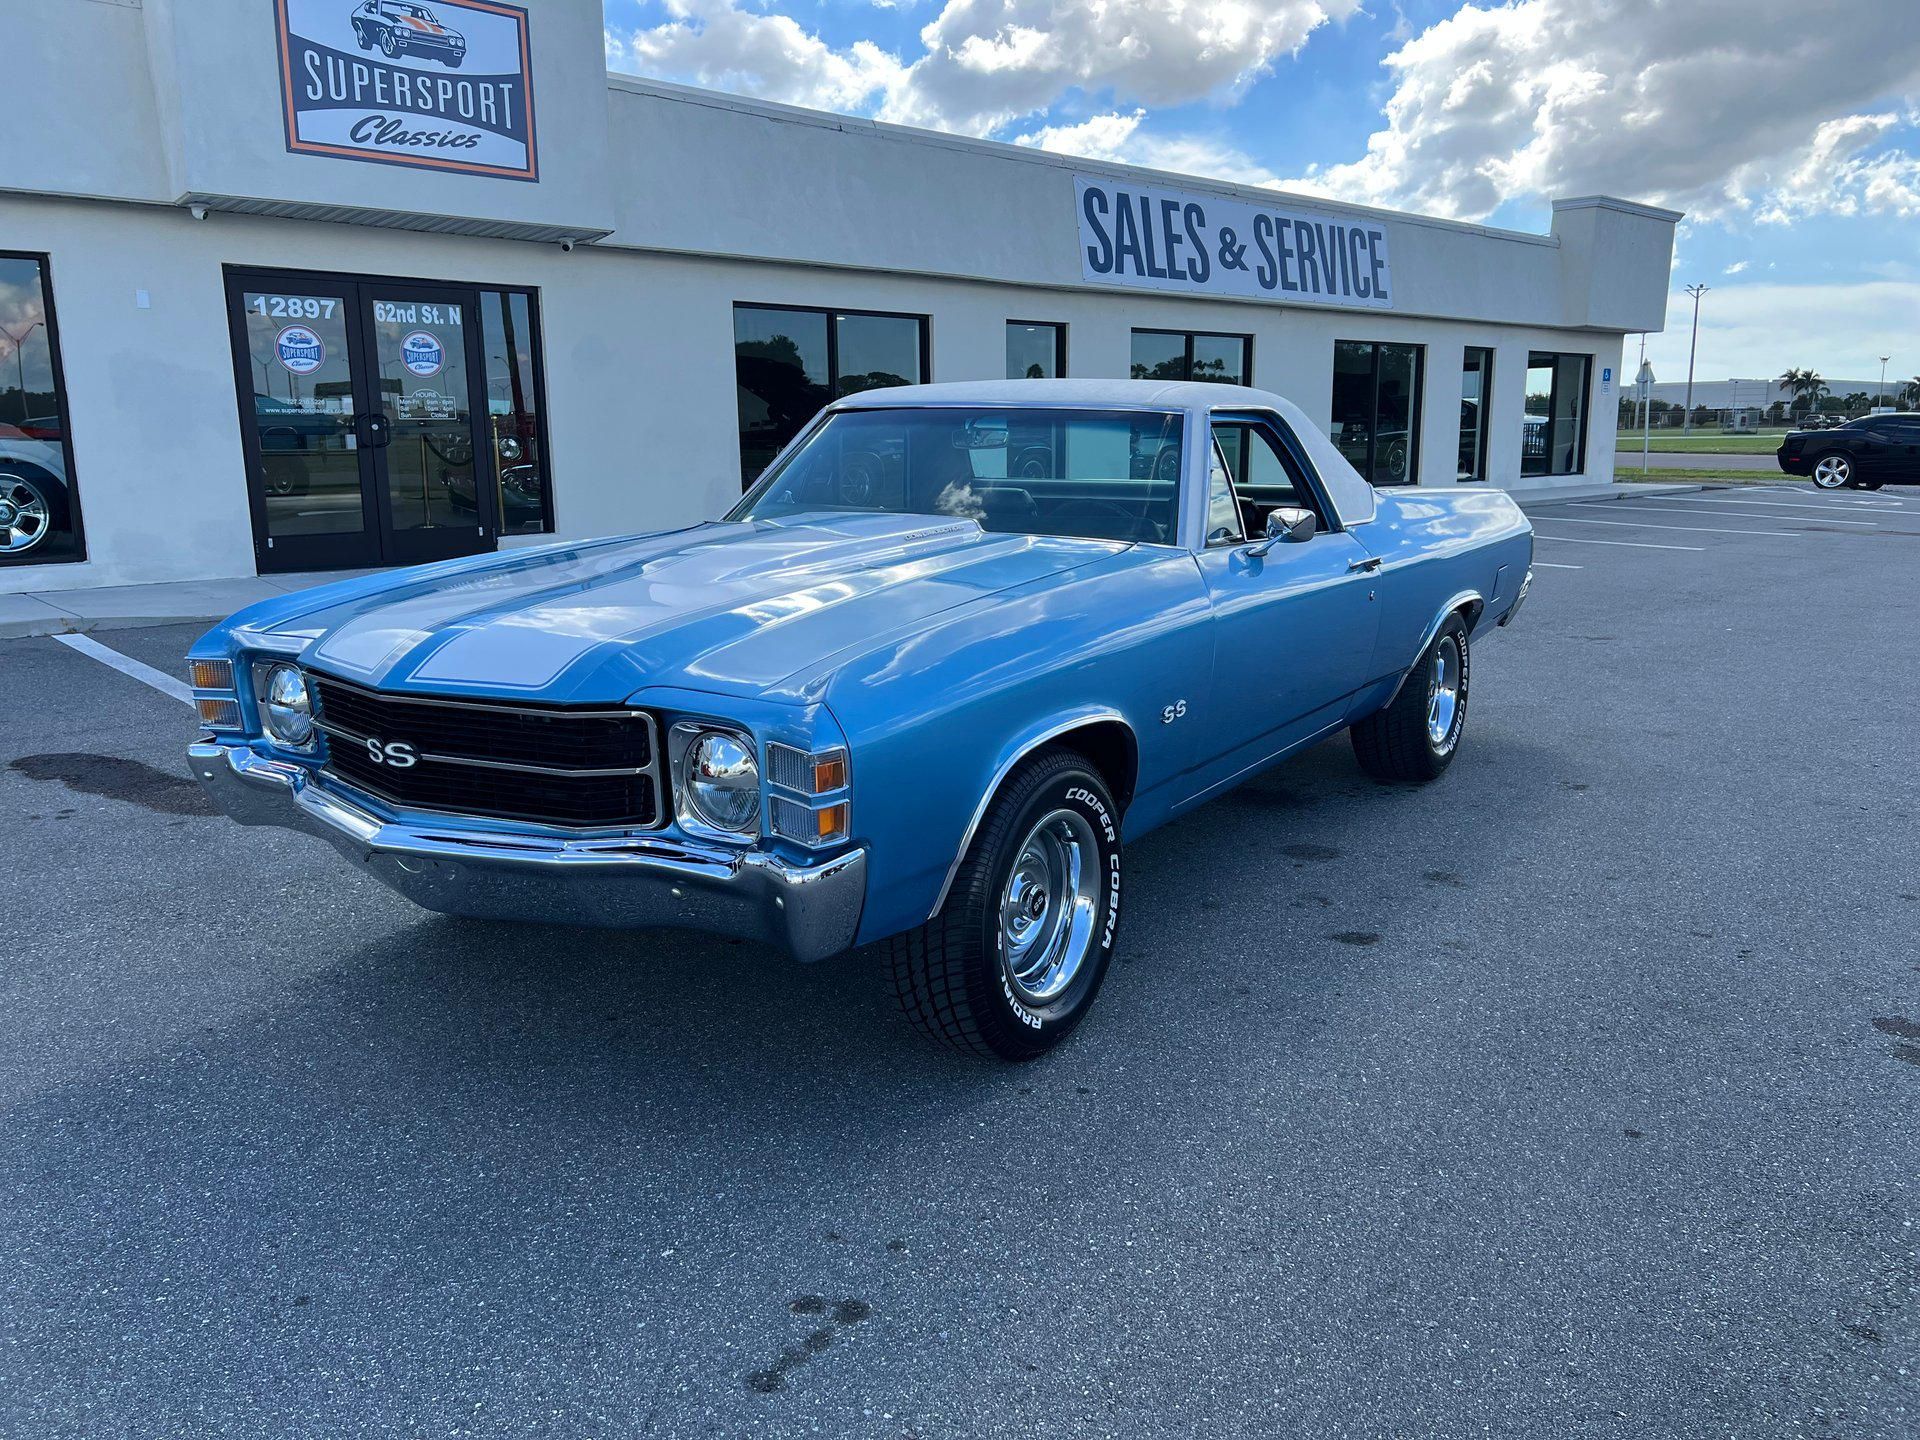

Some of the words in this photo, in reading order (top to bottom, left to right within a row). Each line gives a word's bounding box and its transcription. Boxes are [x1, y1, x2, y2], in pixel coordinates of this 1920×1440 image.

[304, 49, 513, 130] SUPERSPORT
[349, 114, 481, 149] Classics
[1083, 186, 1210, 284] SALES
[1218, 226, 1249, 271] &
[1253, 213, 1388, 300] SERVICE
[253, 296, 336, 320] 12897
[375, 303, 417, 324] 62nd
[421, 305, 445, 325] St.
[448, 306, 461, 325] N
[282, 346, 319, 360] SUPERSPORT
[406, 351, 439, 363] SUPERSPORT
[1457, 630, 1468, 692] COOPER
[1162, 699, 1187, 724] SS
[1447, 699, 1465, 751] COBRA
[366, 738, 417, 767] SS
[1065, 787, 1116, 843] COOPER
[1101, 853, 1120, 950] COBRA
